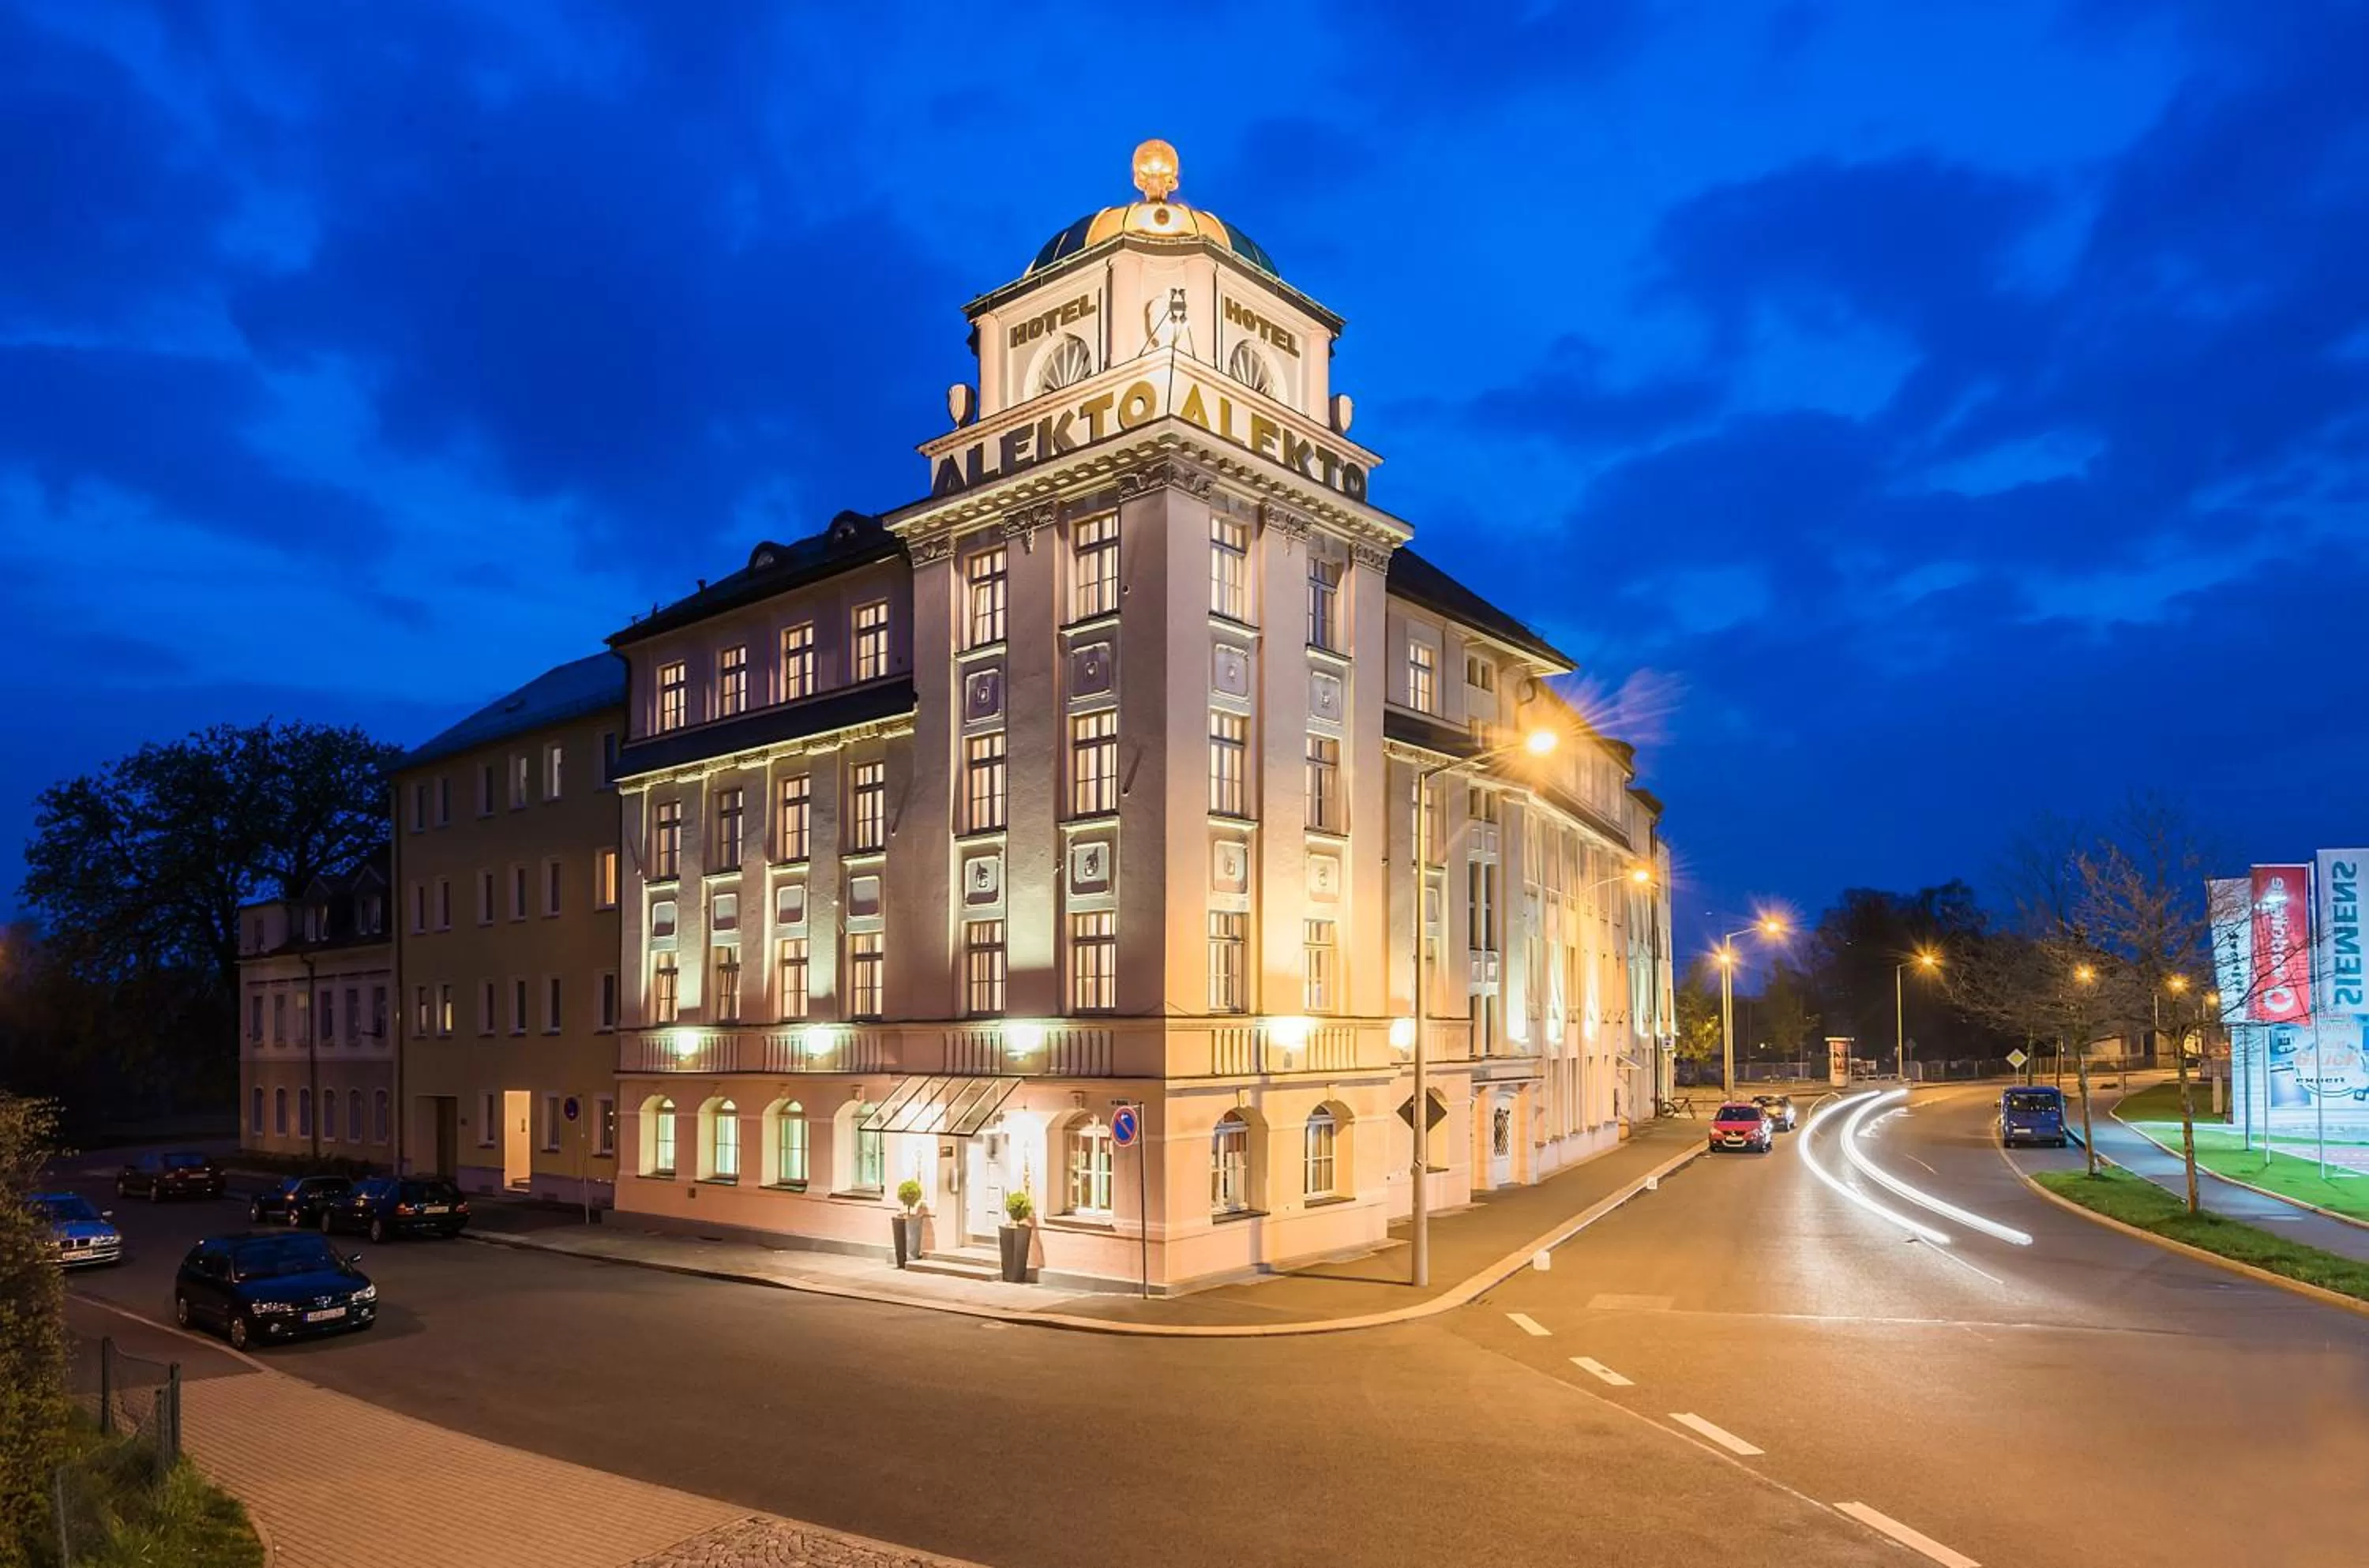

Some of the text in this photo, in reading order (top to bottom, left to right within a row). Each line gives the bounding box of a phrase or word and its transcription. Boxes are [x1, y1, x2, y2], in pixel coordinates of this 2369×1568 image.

[1010, 294, 1097, 349] HOTEL
[1225, 296, 1301, 358] HOTEL
[932, 380, 1158, 497] ALEKTO
[1181, 383, 1368, 503] ALEKTO
